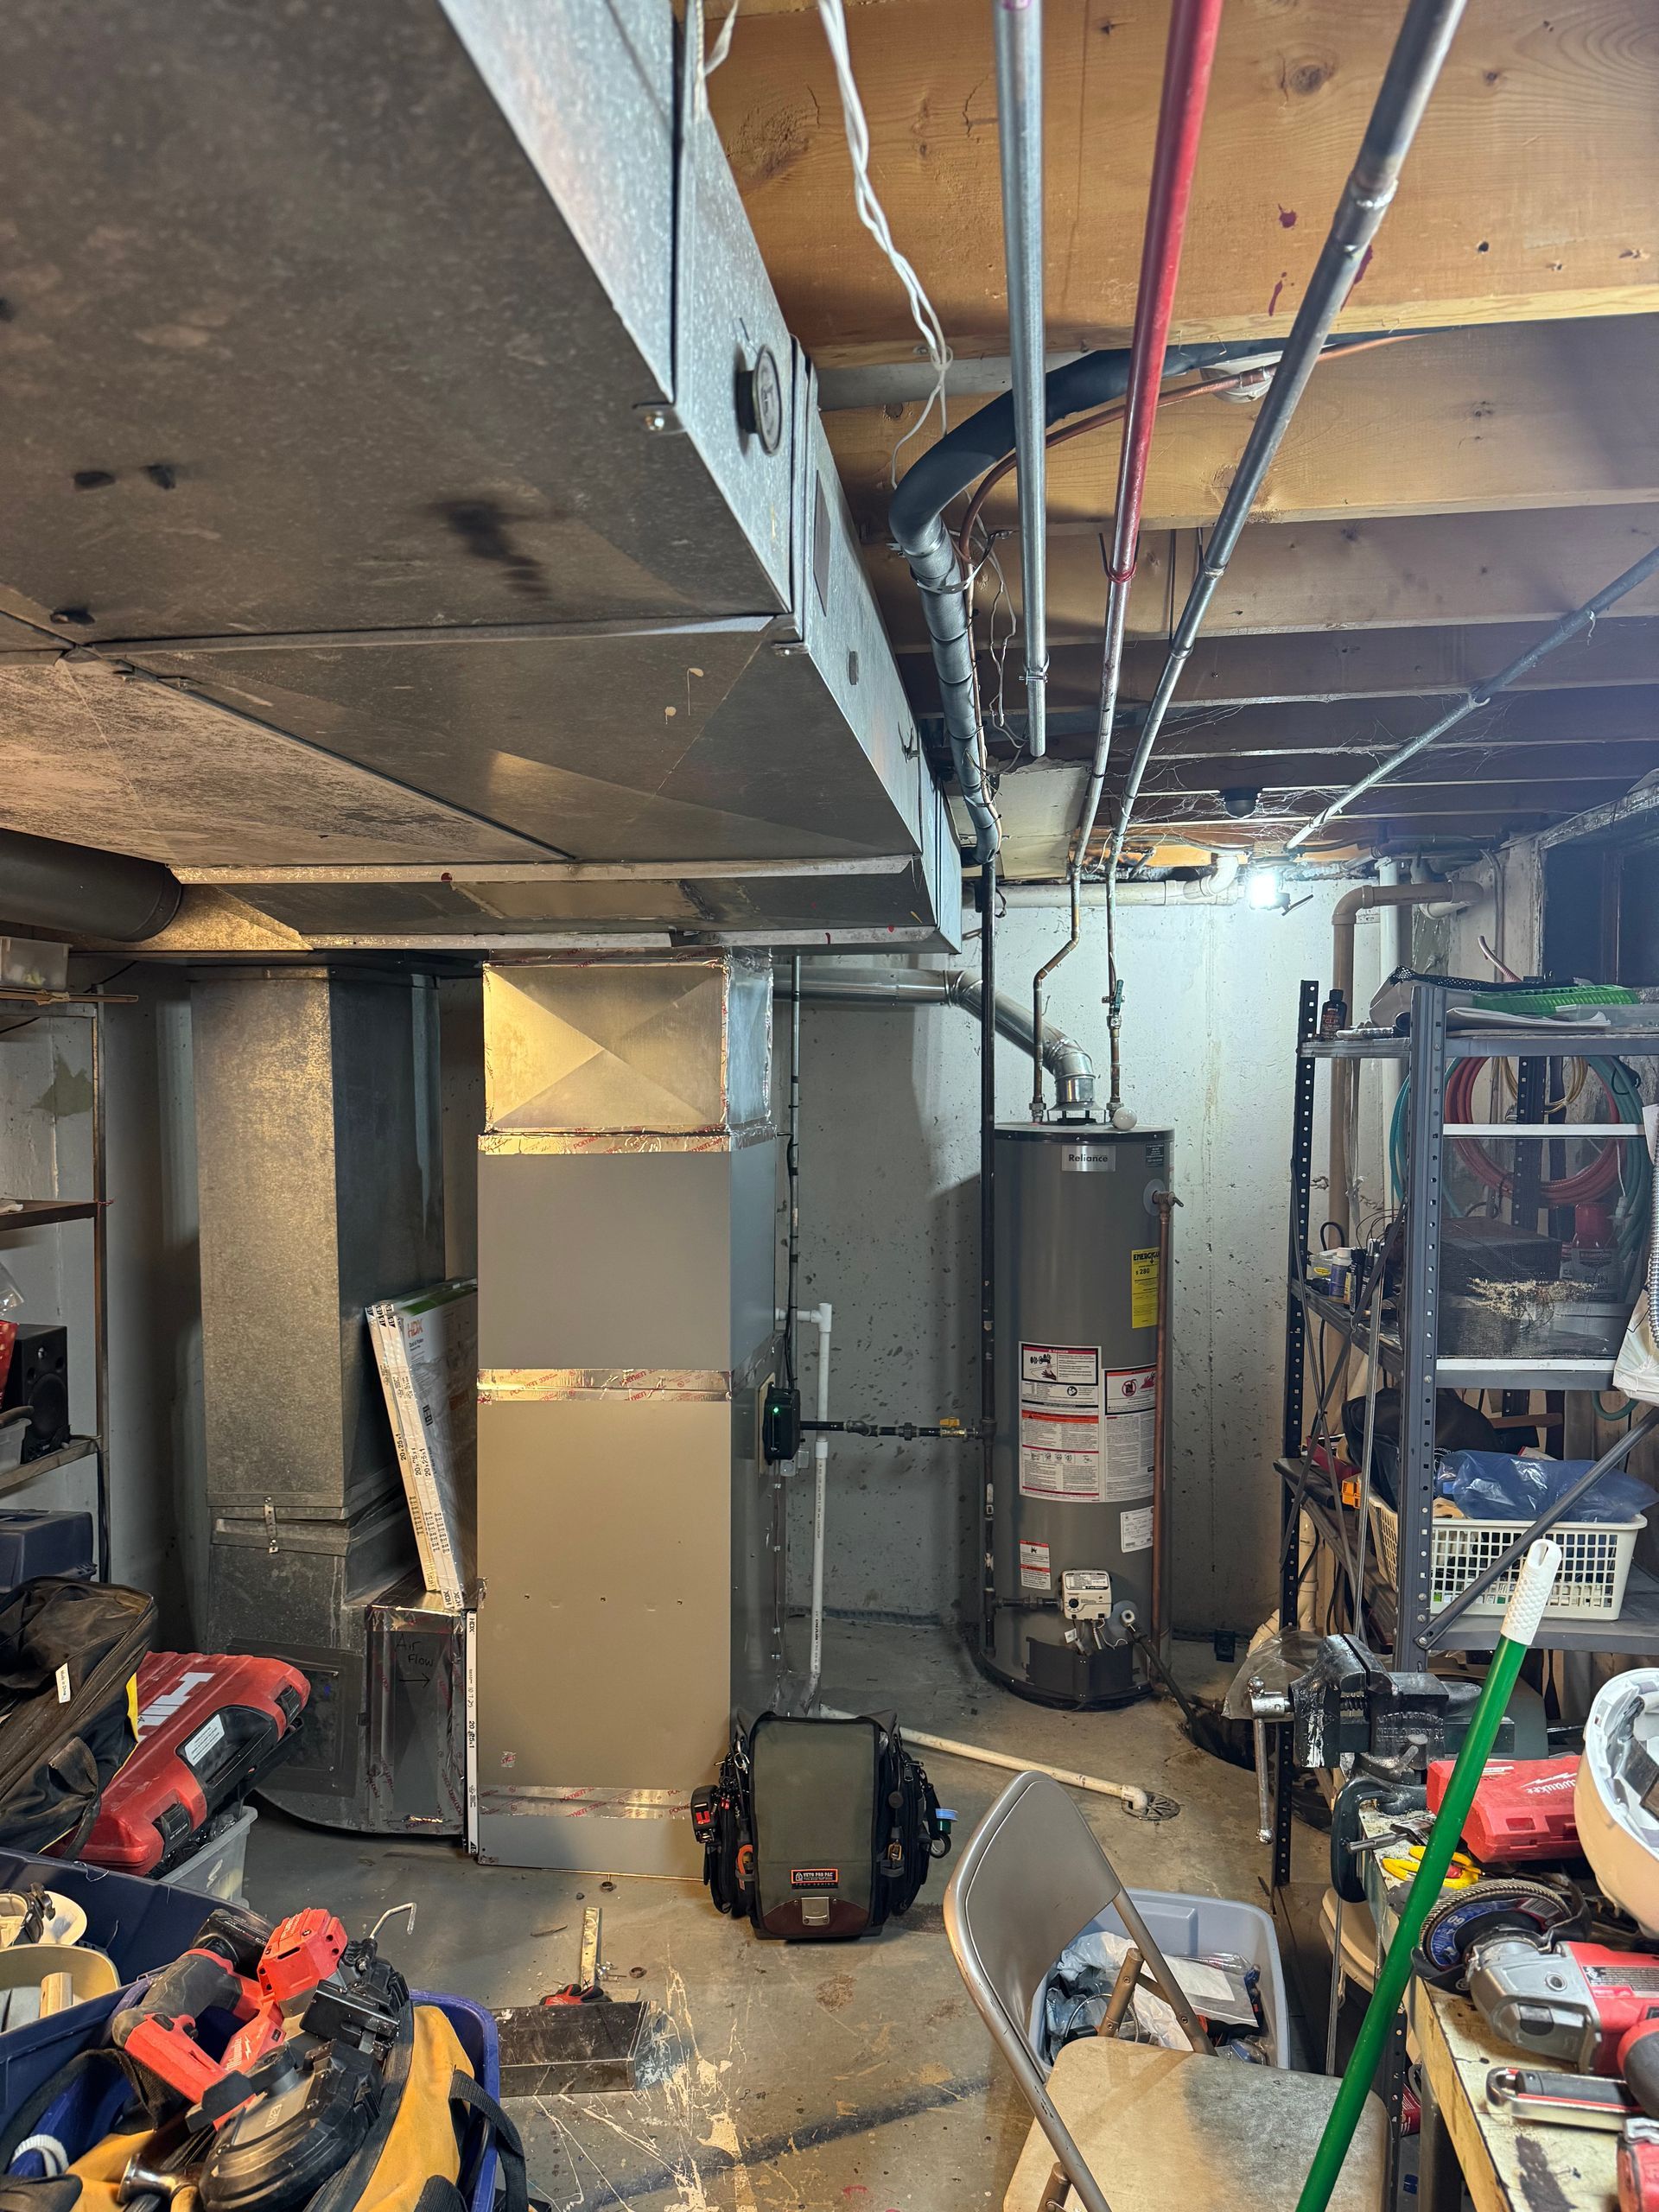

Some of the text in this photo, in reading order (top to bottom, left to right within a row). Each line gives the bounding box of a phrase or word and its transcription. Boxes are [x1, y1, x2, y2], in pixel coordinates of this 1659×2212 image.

[1068, 1154, 1109, 1162] Reliance
[443, 1591, 453, 1606] HDX
[394, 1633, 422, 1651] Air
[408, 1653, 434, 1667] Flow
[137, 1671, 216, 1744] HIL
[1526, 1779, 1577, 1795] waukee
[1447, 1915, 1465, 1926] 60
